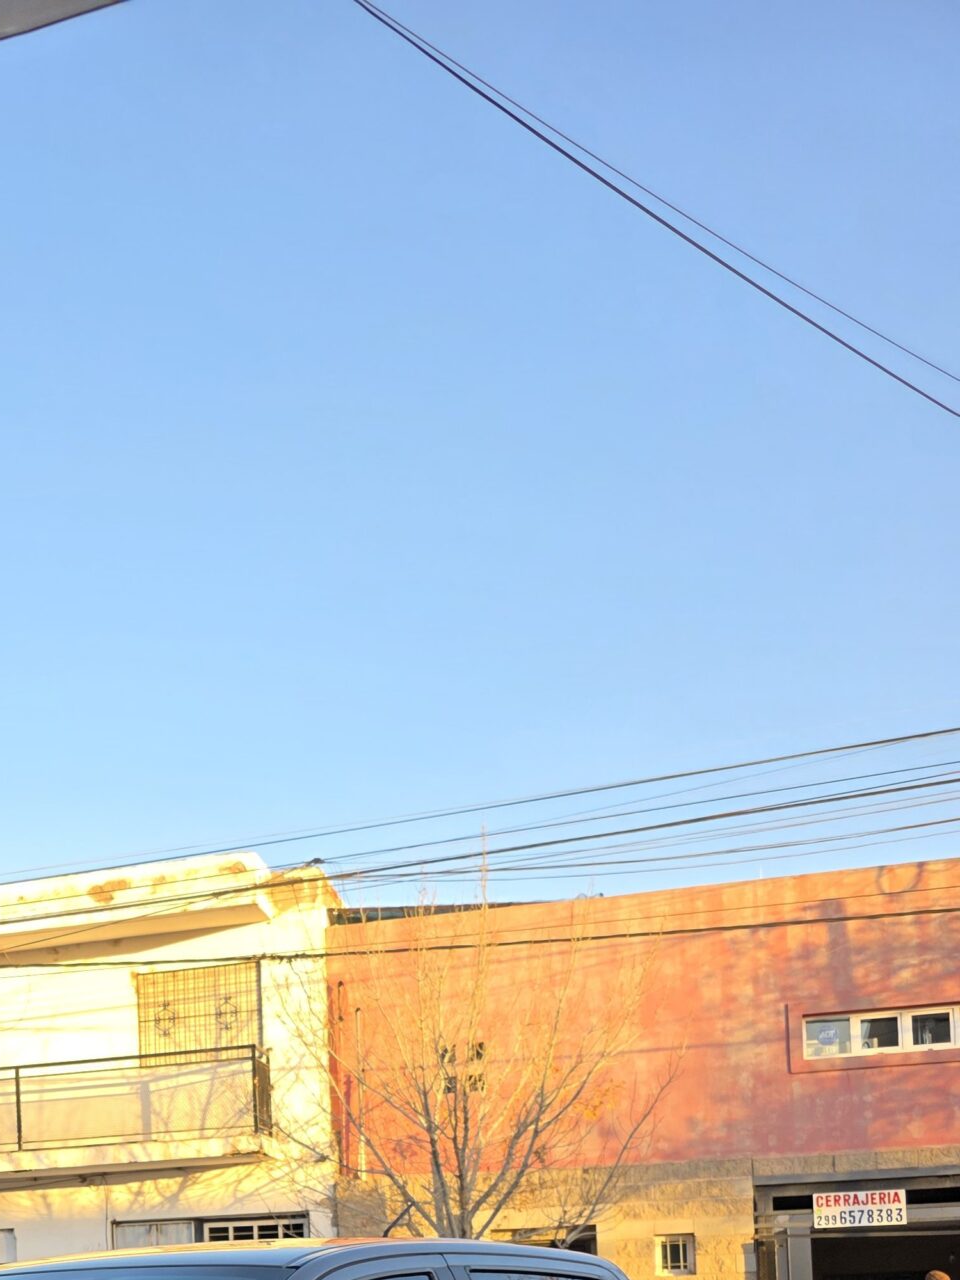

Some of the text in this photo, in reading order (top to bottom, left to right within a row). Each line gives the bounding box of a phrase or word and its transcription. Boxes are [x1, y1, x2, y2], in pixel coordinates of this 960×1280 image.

[816, 1191, 901, 1208] CERRAJERIA
[817, 1208, 903, 1226] 299 6578383
